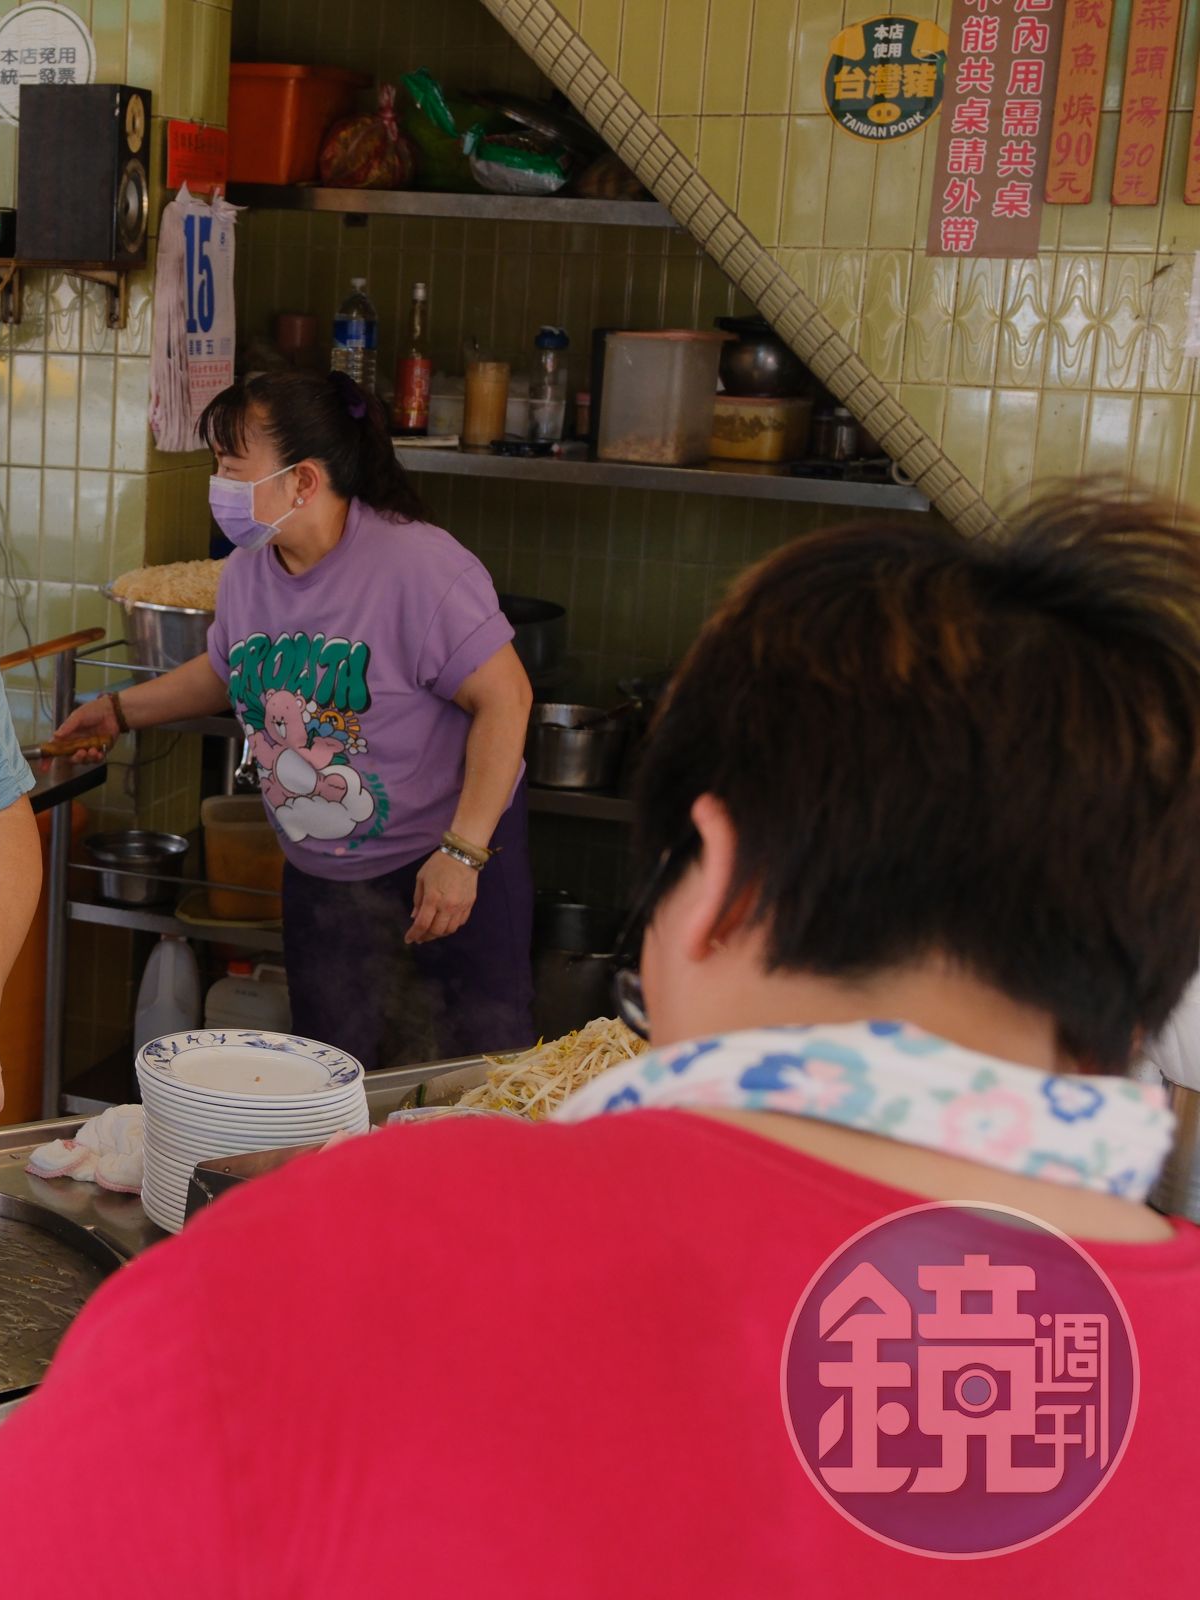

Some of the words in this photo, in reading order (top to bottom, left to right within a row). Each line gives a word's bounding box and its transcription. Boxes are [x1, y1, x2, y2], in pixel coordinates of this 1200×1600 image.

[873, 24, 904, 40] 本店
[0, 47, 76, 65] 本店免用
[873, 43, 902, 58] 使用
[0, 67, 76, 85] 統一發票
[834, 63, 937, 100] 台灣豬
[992, 0, 1051, 218] 內用需共桌
[841, 112, 887, 137] TAIWAN
[889, 111, 925, 136] PORK
[184, 213, 215, 333] 15
